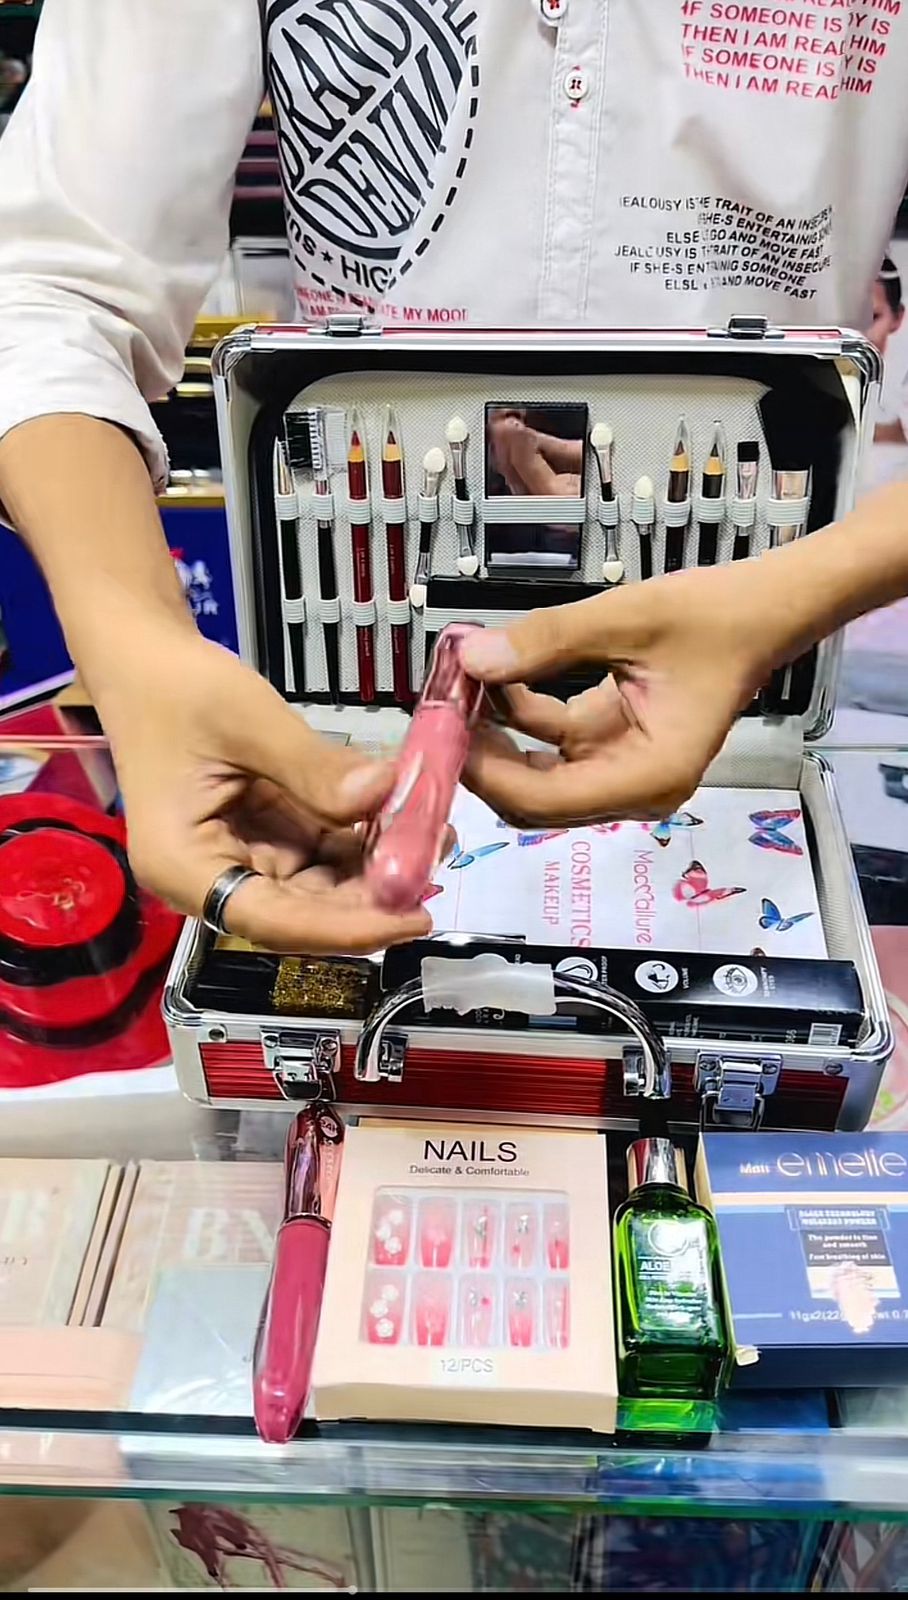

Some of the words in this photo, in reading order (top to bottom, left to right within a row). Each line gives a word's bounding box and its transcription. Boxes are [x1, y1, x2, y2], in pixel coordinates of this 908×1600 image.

[710, 3, 817, 30] SOMEONE
[823, 16, 843, 33] IS
[871, 18, 892, 35] IS
[681, 23, 738, 45] THEN
[754, 32, 787, 48] AM
[850, 34, 887, 56] HIM
[684, 63, 730, 88] THEN
[746, 76, 779, 93] AM
[701, 49, 808, 75] SOMEONE
[816, 62, 835, 78] IS
[857, 57, 877, 75] IS
[715, 198, 753, 217] TRAIT
[755, 211, 774, 225] OF
[775, 217, 797, 230] AN
[667, 230, 700, 244] ELSE
[729, 230, 757, 244] AND
[759, 240, 798, 259] MOVE
[685, 247, 697, 259] IS
[741, 246, 759, 259] OF
[761, 251, 780, 266] AN
[630, 262, 640, 273] IF
[741, 260, 807, 287] SOMEONE
[744, 276, 781, 292] MOVE
[783, 284, 818, 301] FAST
[403, 307, 423, 321] MY
[543, 861, 560, 925] MAKEUP
[571, 841, 592, 948] COSMETICS
[424, 1140, 517, 1162] NAILS
[409, 1165, 452, 1175] Delicate
[454, 1166, 463, 1176] &
[465, 1166, 530, 1177] Comfortable
